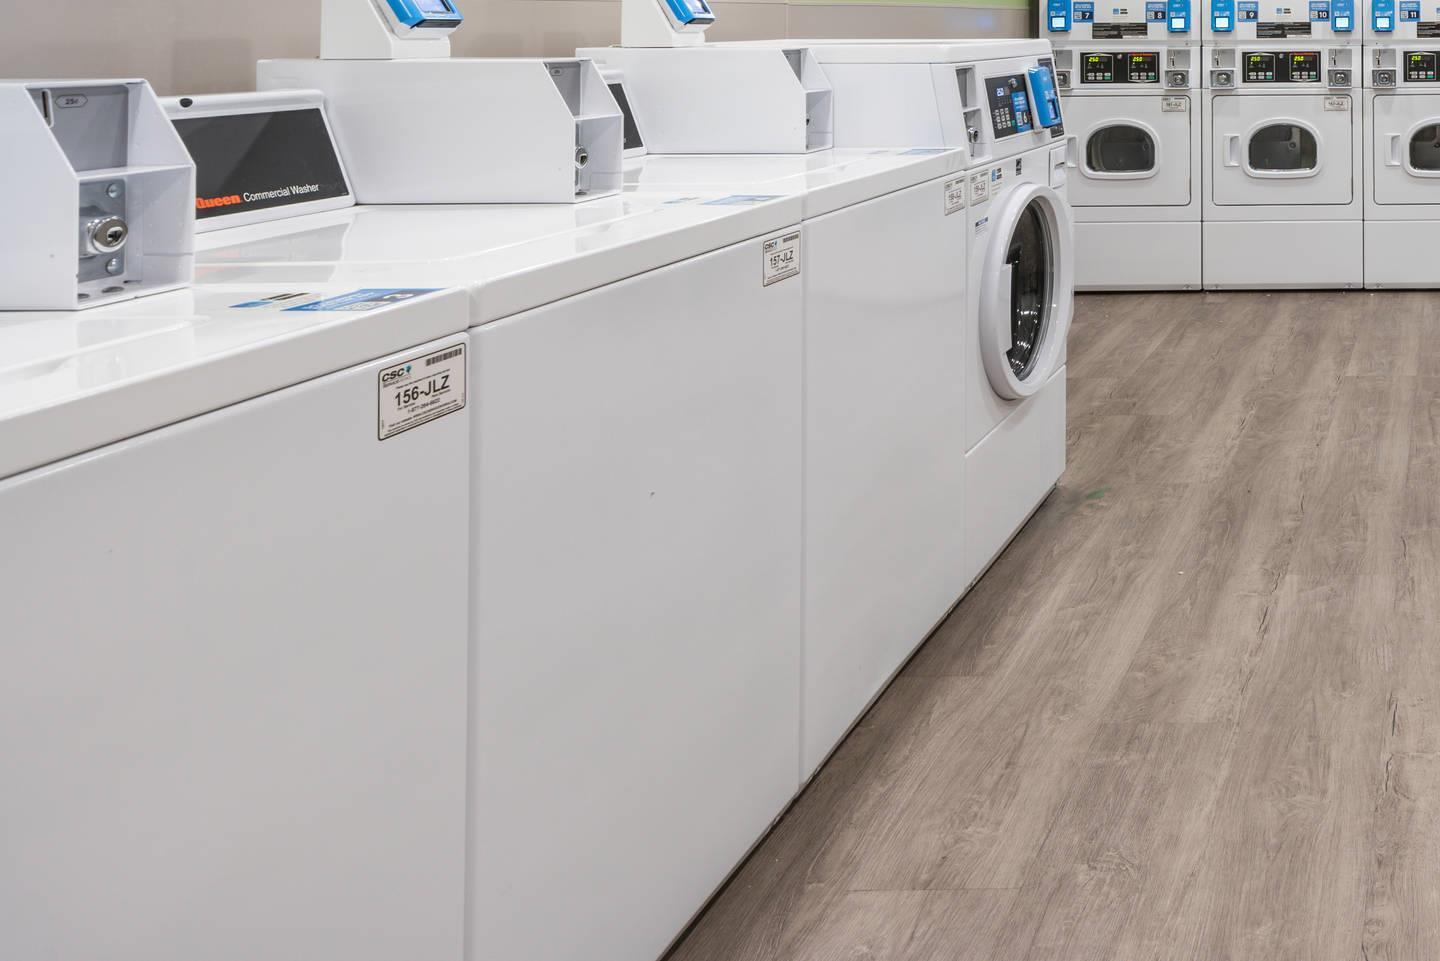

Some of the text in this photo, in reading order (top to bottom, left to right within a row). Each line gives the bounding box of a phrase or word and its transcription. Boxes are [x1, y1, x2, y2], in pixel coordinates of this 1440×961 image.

[1248, 10, 1255, 19] 9
[1318, 10, 1327, 18] 10
[196, 183, 319, 209] Queen Commercial Washer
[769, 249, 794, 266] 157-JLZ
[382, 368, 405, 382] CSC
[395, 374, 450, 406] 156-JLZ
